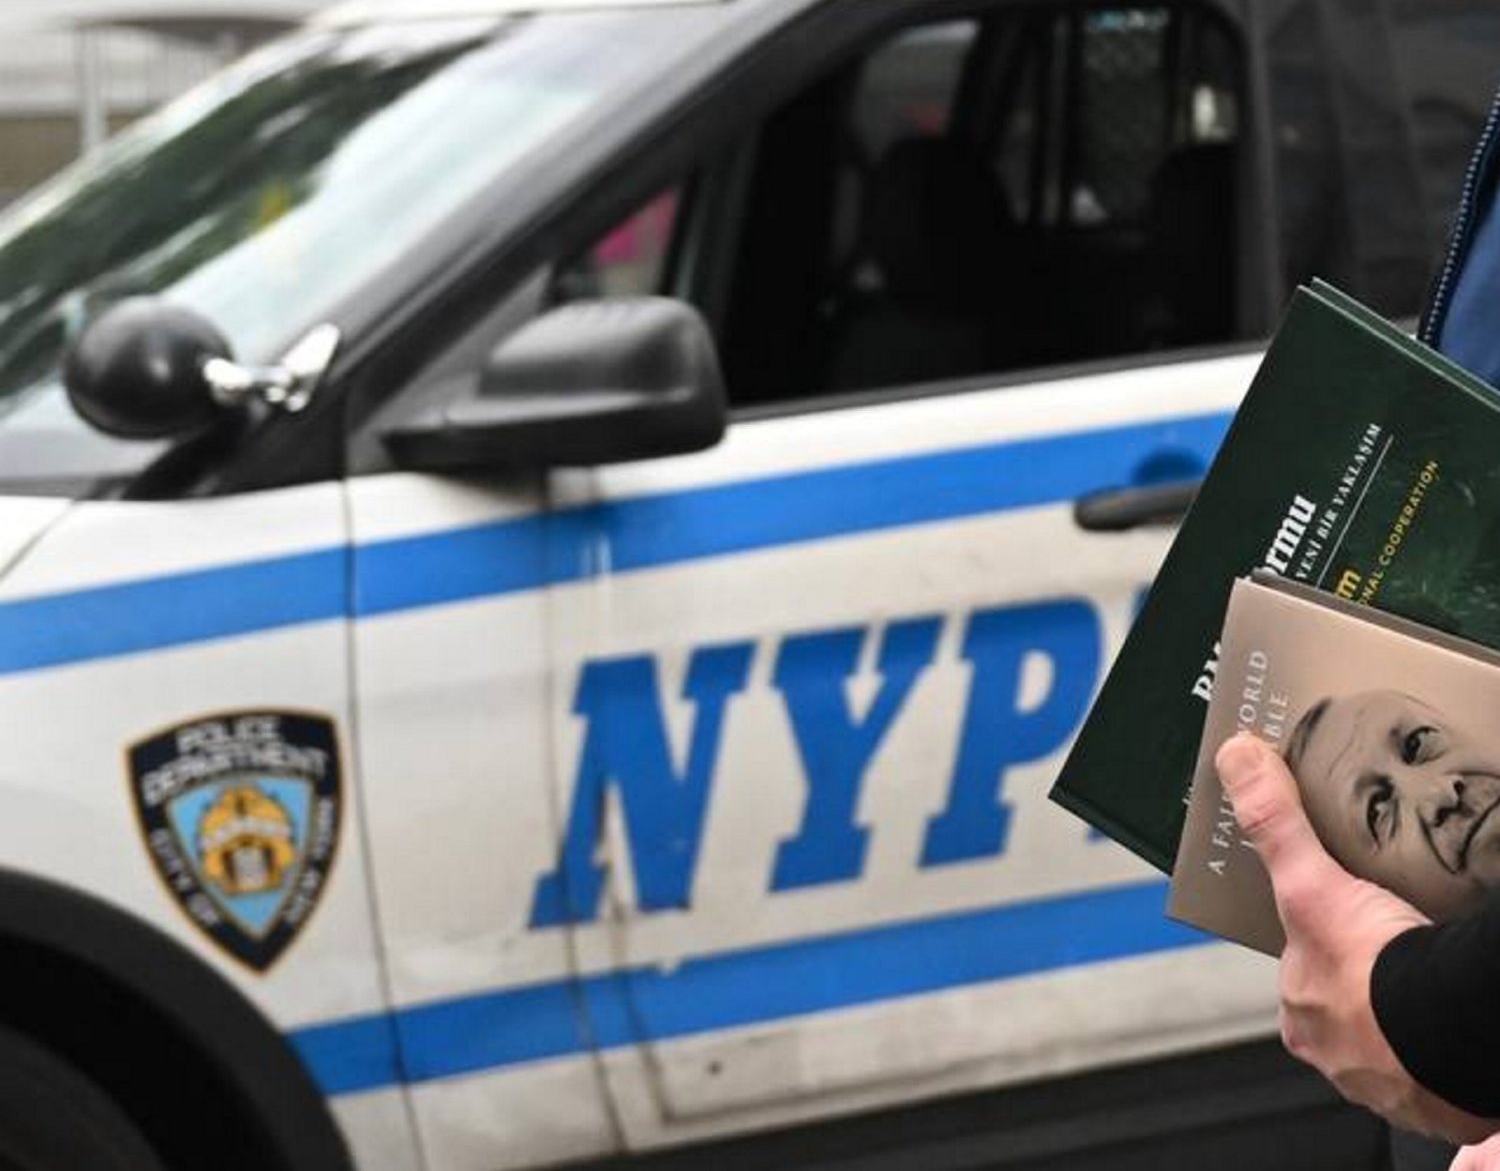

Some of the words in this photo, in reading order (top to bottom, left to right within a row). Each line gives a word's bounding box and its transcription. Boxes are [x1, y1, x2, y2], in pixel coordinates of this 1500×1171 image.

[1332, 423, 1382, 508] YAKLAŞIM
[1378, 460, 1439, 566] COOPERATION
[176, 716, 281, 755] POLICE
[528, 582, 1152, 929] NYP
[143, 742, 327, 807] DEPARTMENT
[1208, 861, 1226, 876] A
